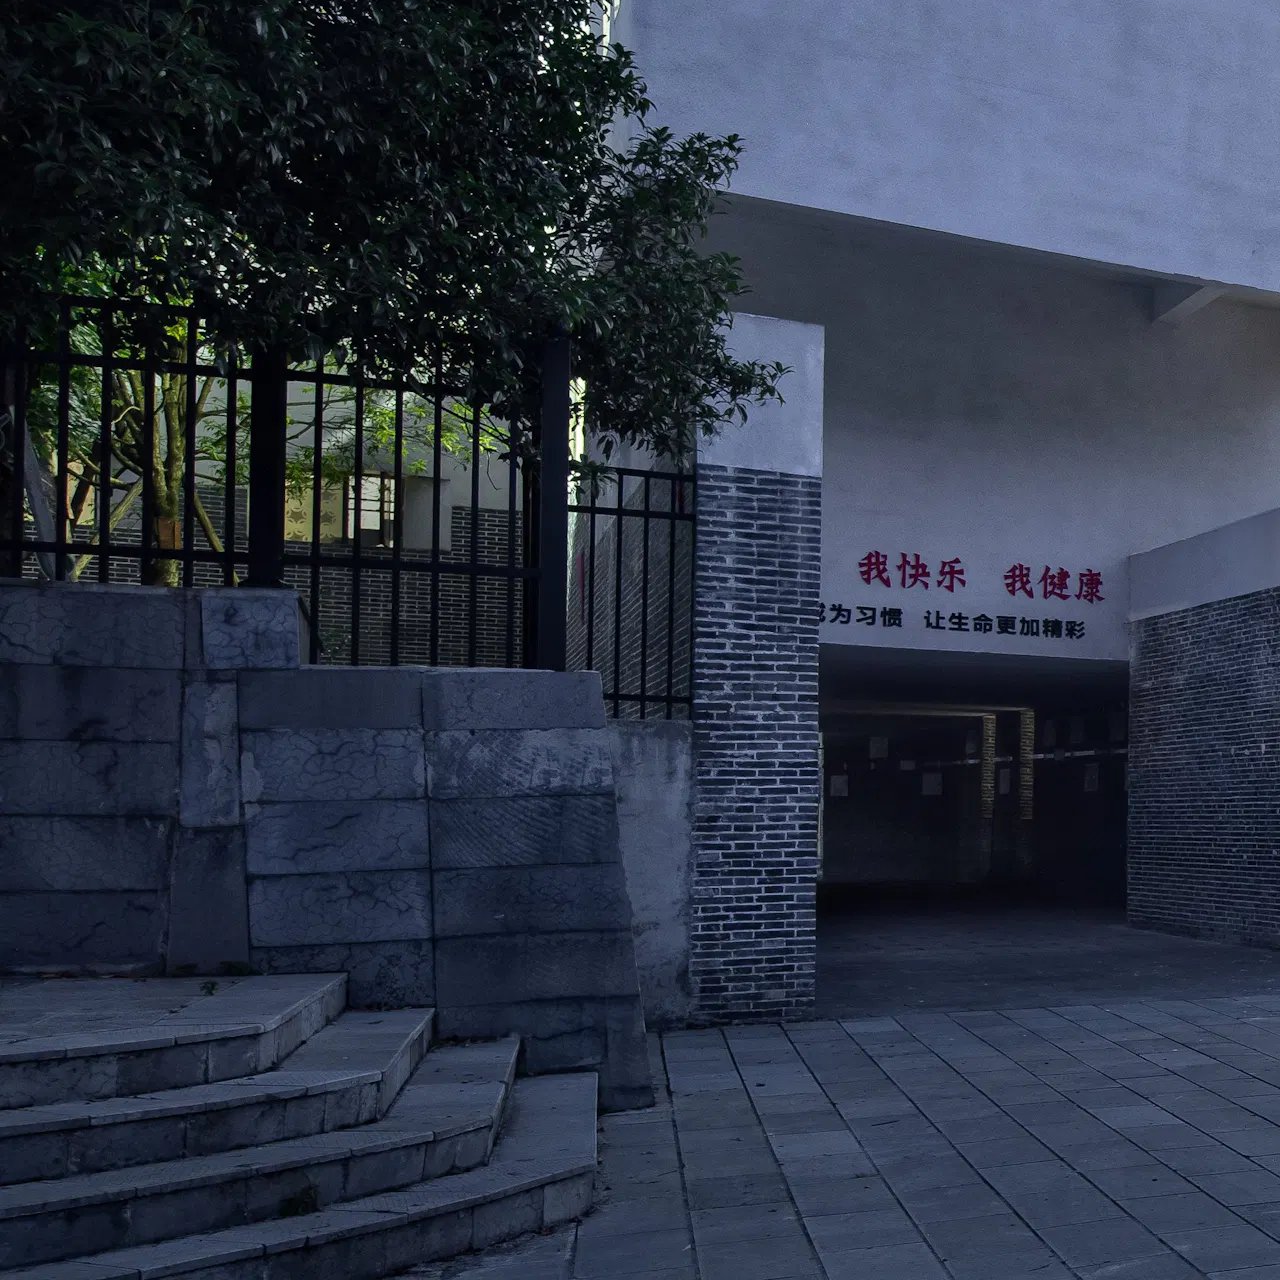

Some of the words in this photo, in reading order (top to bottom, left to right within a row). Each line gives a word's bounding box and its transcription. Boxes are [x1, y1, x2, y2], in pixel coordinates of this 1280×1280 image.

[858, 549, 967, 593] 我快乐
[1003, 562, 1106, 604] 我健康
[923, 610, 1086, 640] 让生命更加精彩
